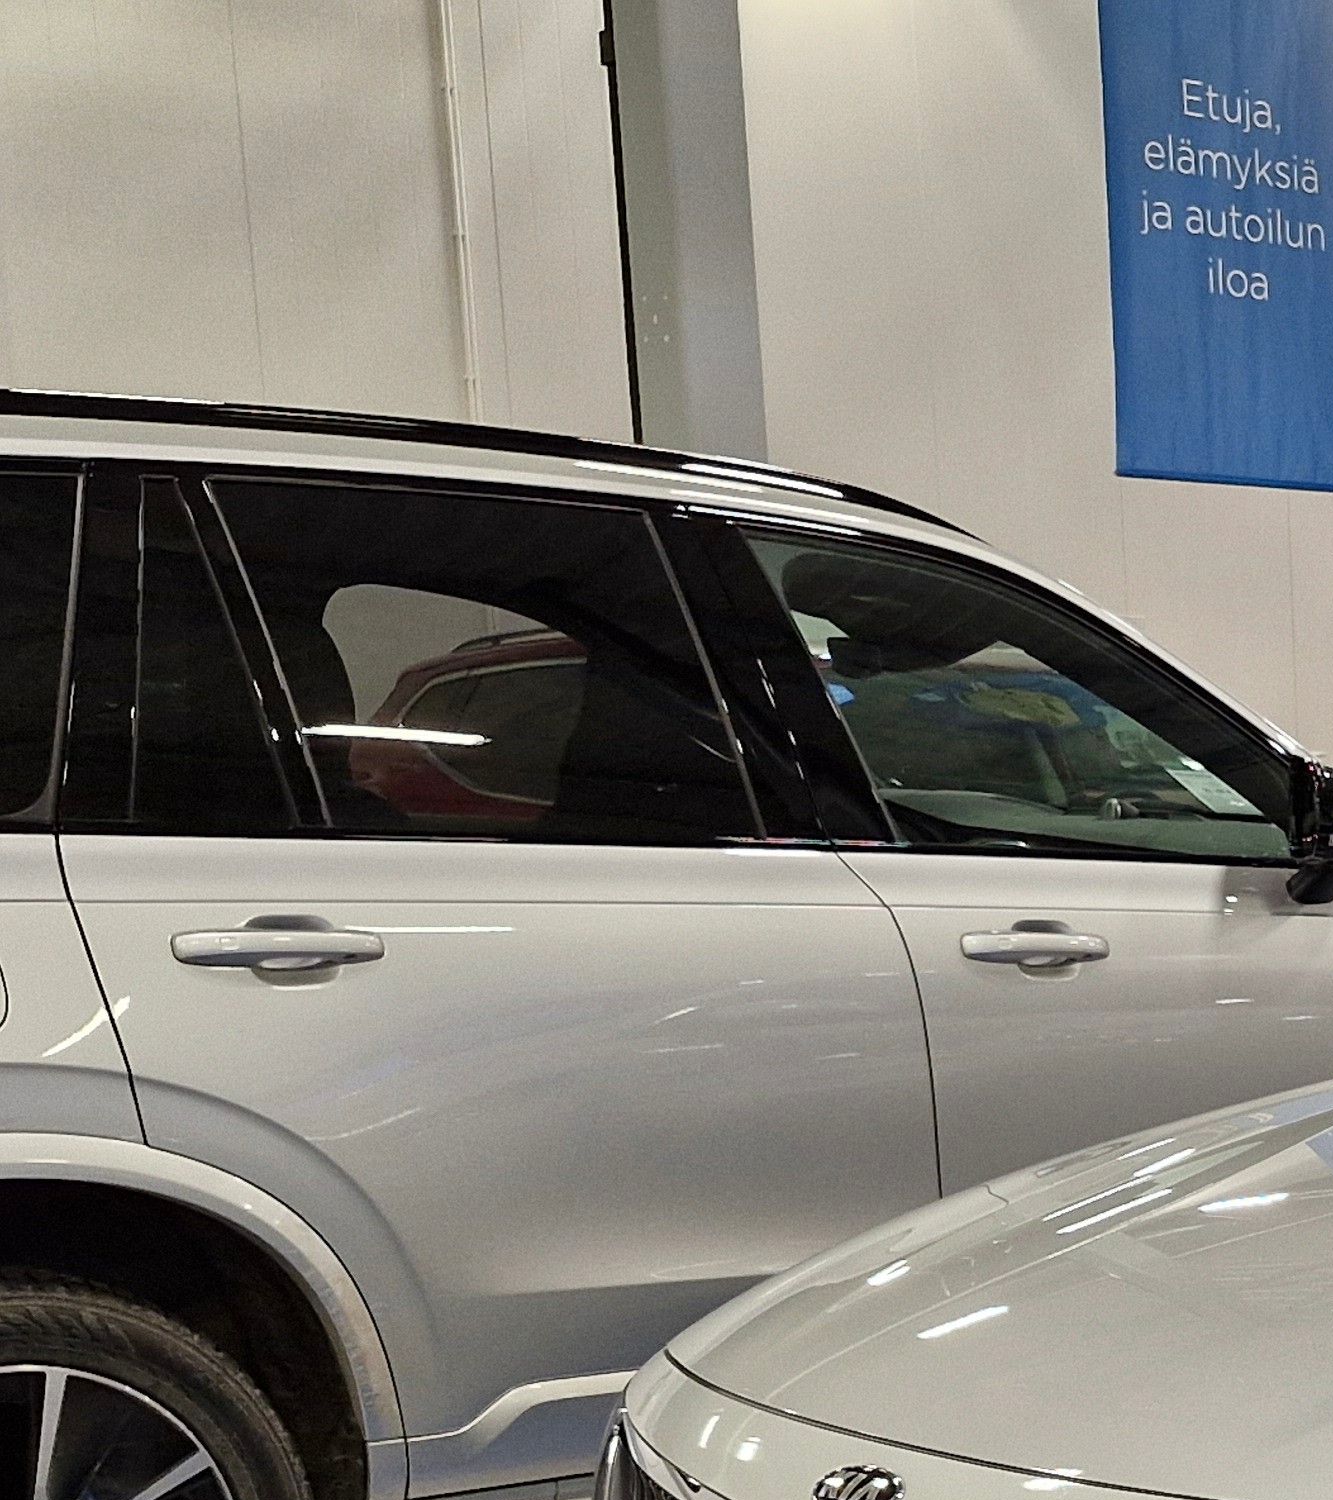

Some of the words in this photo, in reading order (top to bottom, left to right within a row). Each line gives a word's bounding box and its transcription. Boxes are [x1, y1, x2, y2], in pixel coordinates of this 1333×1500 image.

[1181, 77, 1282, 136] Etuja,
[1143, 133, 1320, 195] elämyksiä
[1139, 189, 1173, 235] ja
[1184, 204, 1327, 252] autoilun
[1207, 257, 1270, 301] iloa
